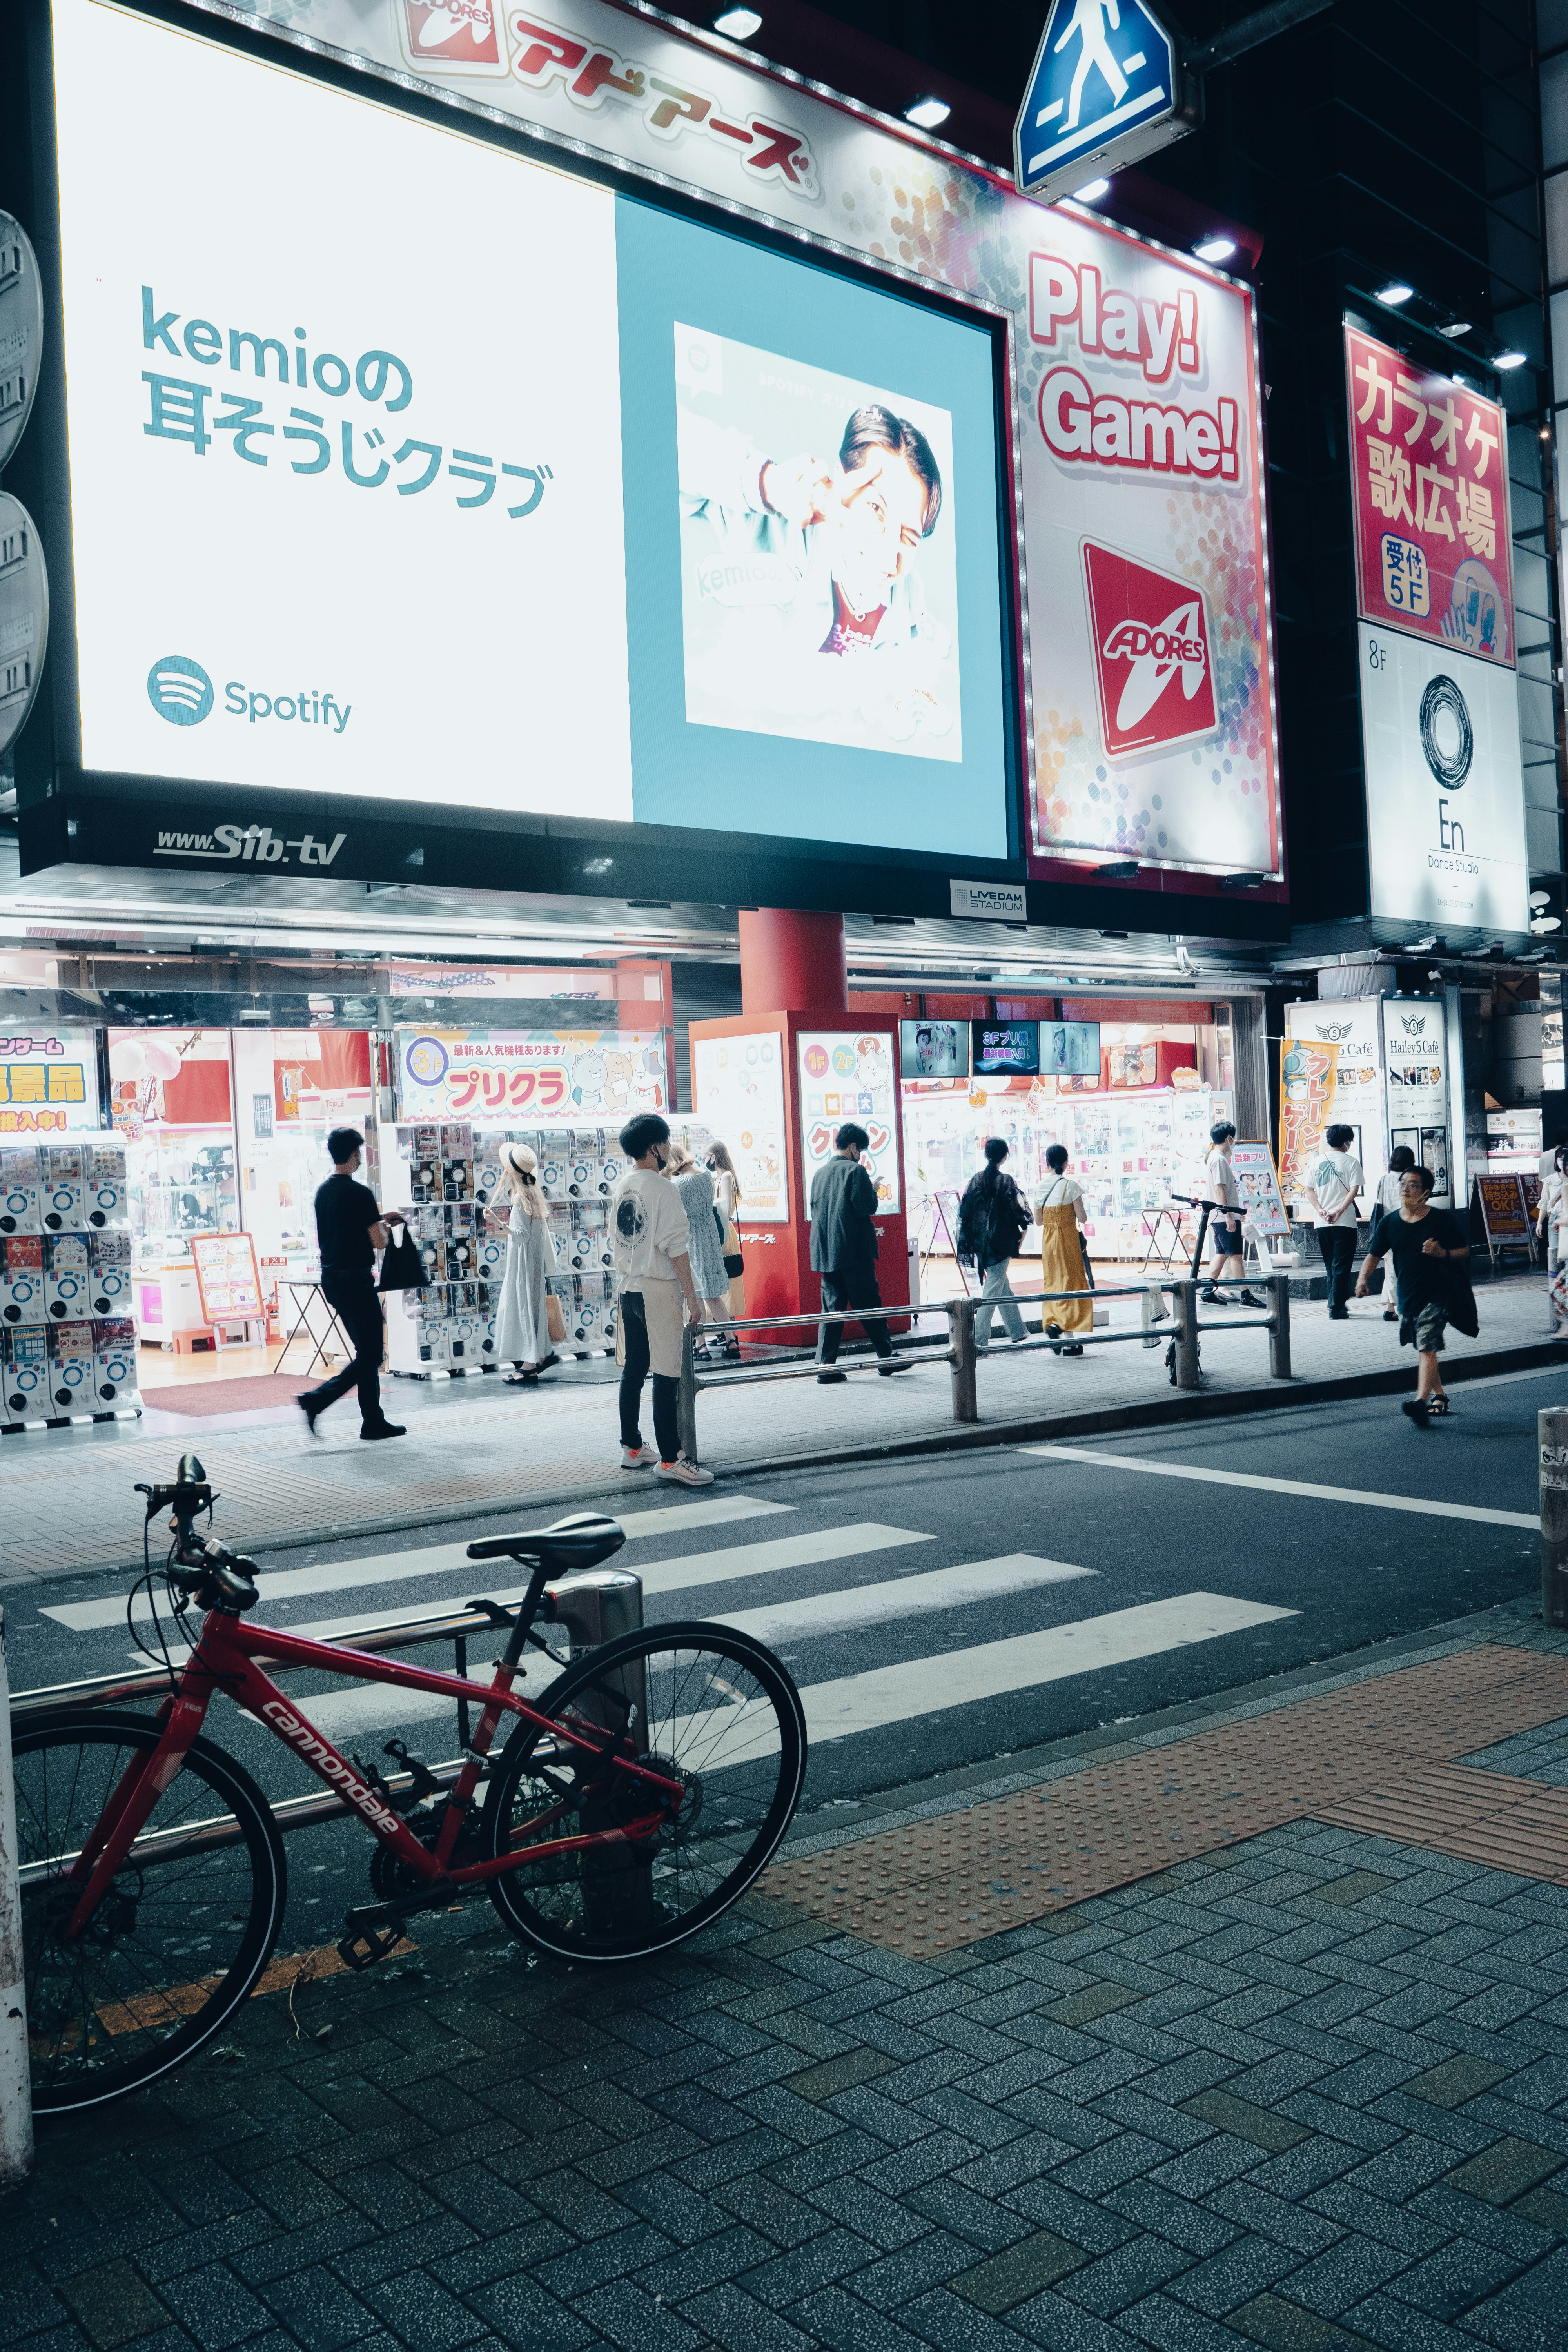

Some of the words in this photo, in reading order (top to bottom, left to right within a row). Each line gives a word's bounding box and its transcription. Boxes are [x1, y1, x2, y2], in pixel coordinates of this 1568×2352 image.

[517, 20, 808, 184] アドアーズ
[1029, 251, 1199, 384] Play!
[142, 285, 413, 412] kemioの
[1038, 366, 1239, 482] Game!
[1355, 355, 1498, 479] カラオケ
[142, 370, 554, 519] 耳そうじクラブ
[1367, 435, 1496, 560] 歌広場
[1386, 539, 1423, 578] 受付
[1390, 573, 1423, 612] 5F
[1107, 630, 1203, 662] ADORES
[1369, 639, 1387, 671] 8F
[225, 682, 352, 733] Spotify
[1438, 798, 1465, 853] En
[1428, 855, 1454, 870] Dance
[1455, 859, 1479, 874] Studio
[969, 889, 1022, 902] LIVEDAM
[970, 900, 1023, 911] STADIUM
[414, 1049, 442, 1073] 3F
[809, 1052, 825, 1070] 1F
[836, 1052, 853, 1070] 2F
[1347, 1042, 1373, 1055] Café
[1423, 1040, 1439, 1053] Café
[0, 1063, 86, 1103] 景品
[449, 1071, 564, 1108] プリクラ
[1301, 1053, 1331, 1149] クレーン
[325, 1100, 344, 1108] TRIPLE
[1234, 1152, 1267, 1163] 最新プリ
[1281, 1103, 1308, 1176] ゲーム
[1484, 1191, 1518, 1201] 持ち込み
[1491, 1200, 1514, 1211] OK!
[263, 1701, 399, 1834] cannondale
